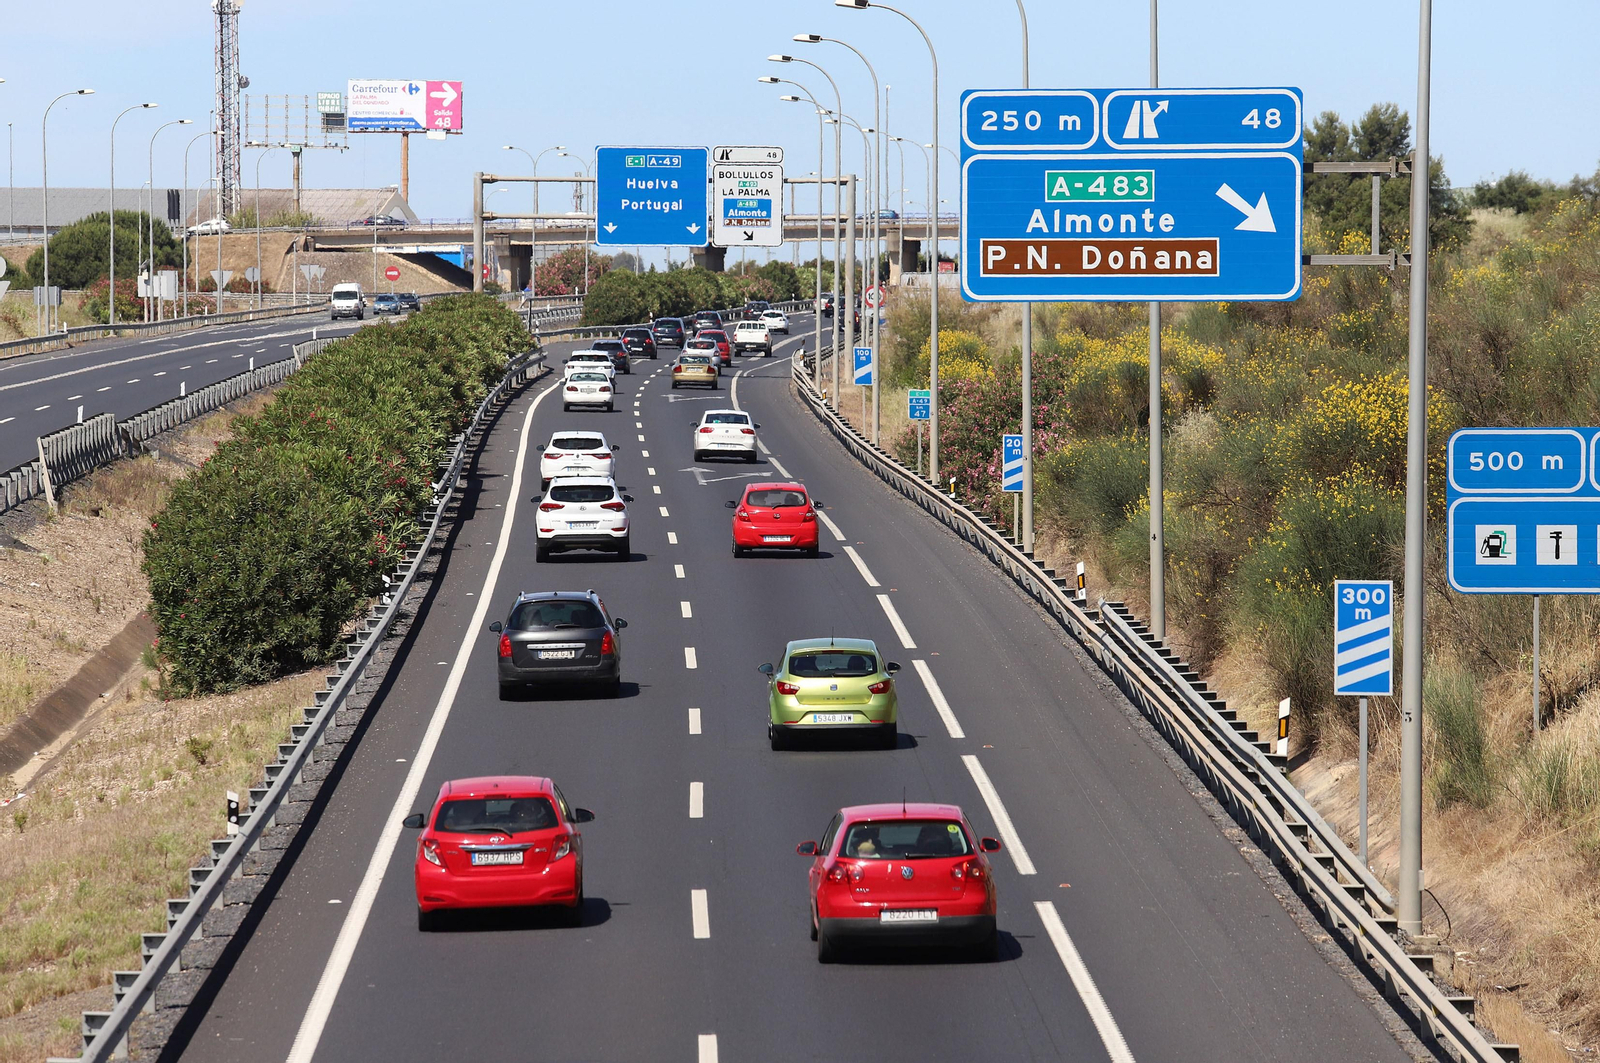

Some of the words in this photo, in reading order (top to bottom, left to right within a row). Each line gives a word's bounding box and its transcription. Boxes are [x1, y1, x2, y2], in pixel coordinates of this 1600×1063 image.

[352, 84, 398, 93] Carrefour
[434, 118, 451, 127] 48
[981, 110, 1042, 132] 250
[1059, 114, 1081, 131] m
[1242, 108, 1282, 129] 48
[649, 158, 679, 166] A-49
[626, 178, 678, 189] Huelva
[1051, 175, 1149, 196] A-483
[621, 199, 682, 212] Portugal
[728, 209, 767, 217] Almonte
[1026, 208, 1175, 233] Almonte
[987, 245, 1060, 270] P.N.
[1082, 246, 1212, 270] Doñana
[1006, 439, 1024, 448] 20
[1469, 452, 1524, 471] 500
[1542, 454, 1564, 470] m
[1342, 588, 1386, 604] 300
[1354, 607, 1372, 620] m
[478, 852, 500, 862] 6937
[504, 852, 521, 861] HPS
[890, 911, 914, 919] 8220
[917, 910, 933, 918] FLY
